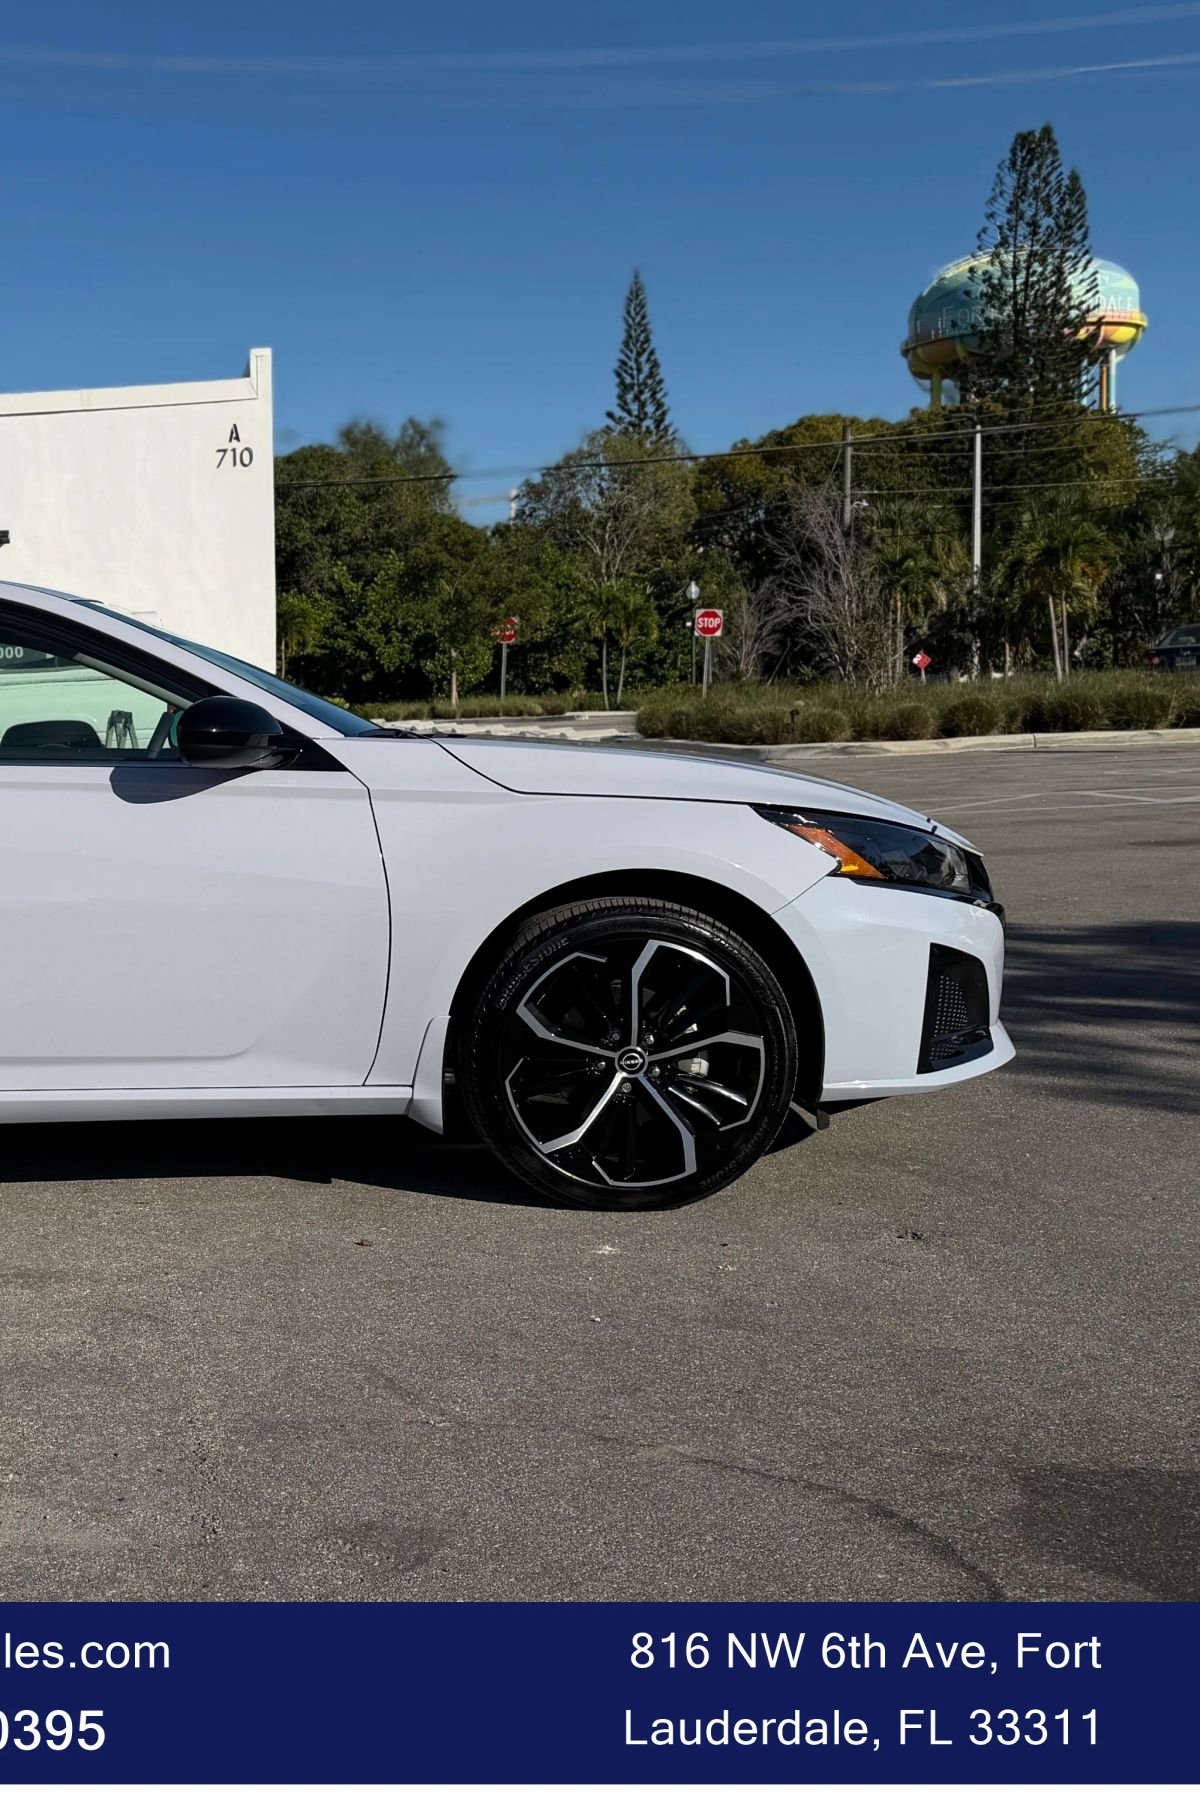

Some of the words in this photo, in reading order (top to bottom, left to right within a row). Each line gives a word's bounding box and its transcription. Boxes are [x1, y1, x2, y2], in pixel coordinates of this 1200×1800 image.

[228, 423, 241, 443] A
[215, 446, 254, 470] 710
[697, 617, 721, 629] STOP
